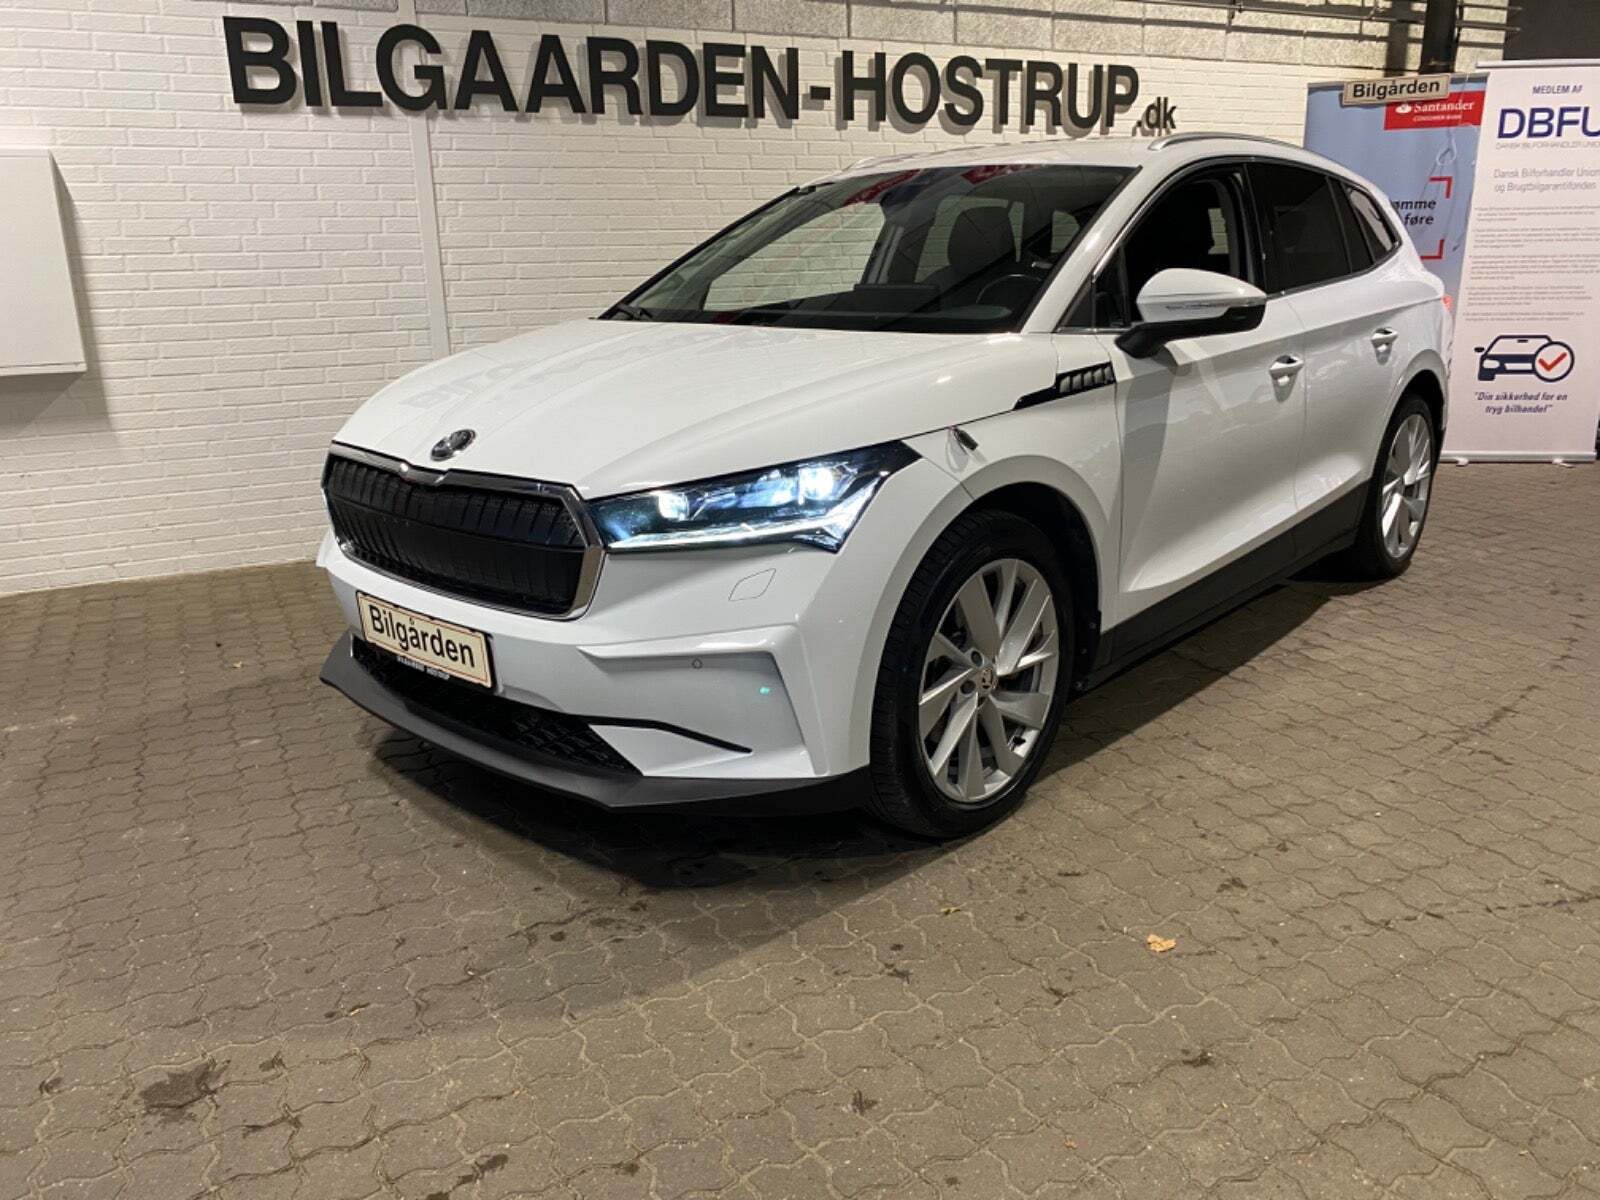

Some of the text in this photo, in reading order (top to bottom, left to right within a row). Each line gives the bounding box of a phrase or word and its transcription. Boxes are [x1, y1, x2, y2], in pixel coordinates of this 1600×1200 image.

[1353, 79, 1440, 100] Bilgården
[1532, 84, 1583, 94] MEDLEM AF
[1414, 100, 1474, 114] Santander
[1497, 106, 1600, 138] DBFU
[1493, 168, 1519, 179] Dansk
[1494, 391, 1541, 401] sikkerhed
[1485, 404, 1503, 415] tryg
[369, 604, 475, 668] Bilgården
